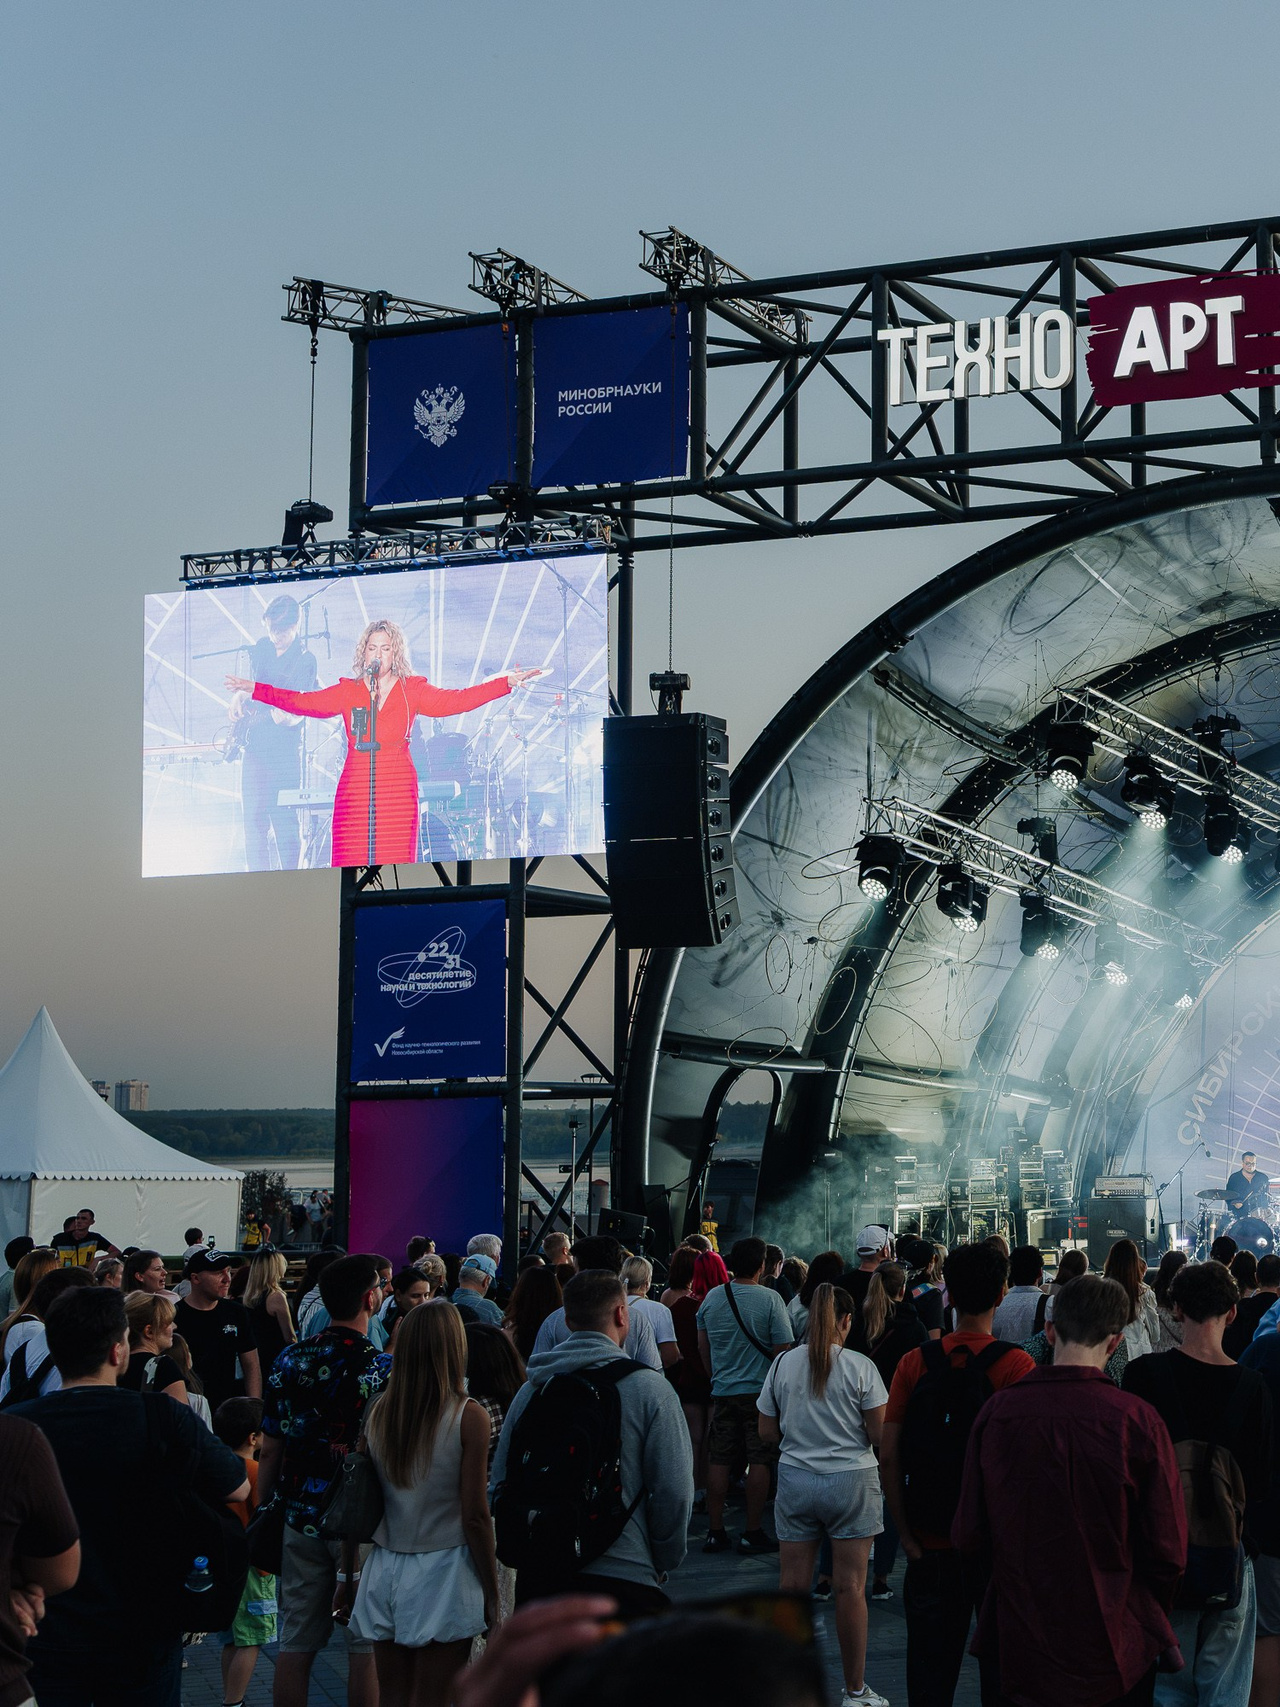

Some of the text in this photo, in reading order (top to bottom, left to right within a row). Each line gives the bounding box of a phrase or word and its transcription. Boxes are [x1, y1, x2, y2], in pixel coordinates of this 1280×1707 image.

[877, 295, 1246, 407] ТЕХНО АРТ
[558, 381, 663, 403] МИНОБРНАУКИ
[558, 402, 613, 418] РОССИИ
[429, 942, 449, 957] 22
[444, 954, 461, 969] 31
[408, 970, 472, 981] десятилетие
[380, 978, 472, 994] науки и технологий
